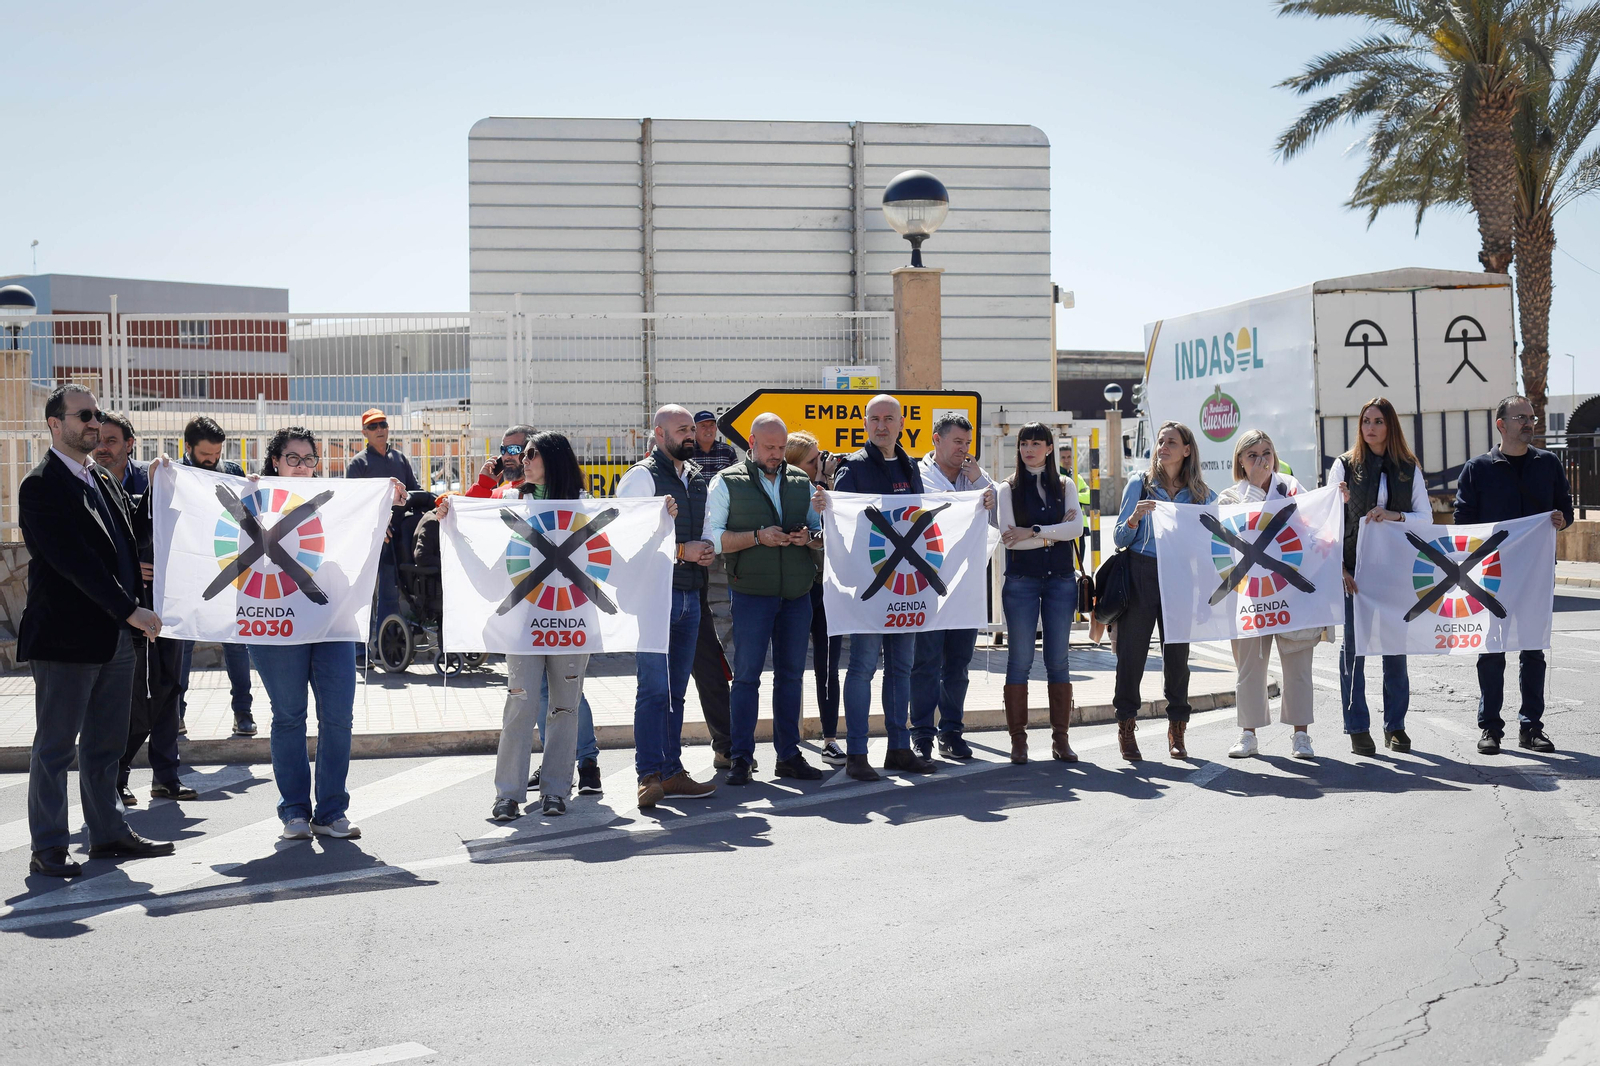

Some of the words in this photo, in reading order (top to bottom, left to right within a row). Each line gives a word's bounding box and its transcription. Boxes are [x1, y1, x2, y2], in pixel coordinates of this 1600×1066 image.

[1175, 327, 1264, 381] INDASOL
[805, 404, 921, 420] EMBAE
[1201, 403, 1239, 431] Quesada
[835, 428, 921, 448] FEY
[236, 606, 295, 618] AGENDA
[887, 601, 927, 612] AGENDA
[1240, 600, 1289, 614] AGENDA
[236, 619, 294, 637] 2030
[530, 618, 587, 628] AGENDA
[884, 612, 926, 628] 2030
[1241, 610, 1291, 631] 2030
[1434, 623, 1483, 633] AGENDA
[531, 630, 587, 647] 2030
[1434, 634, 1482, 649] 2030
